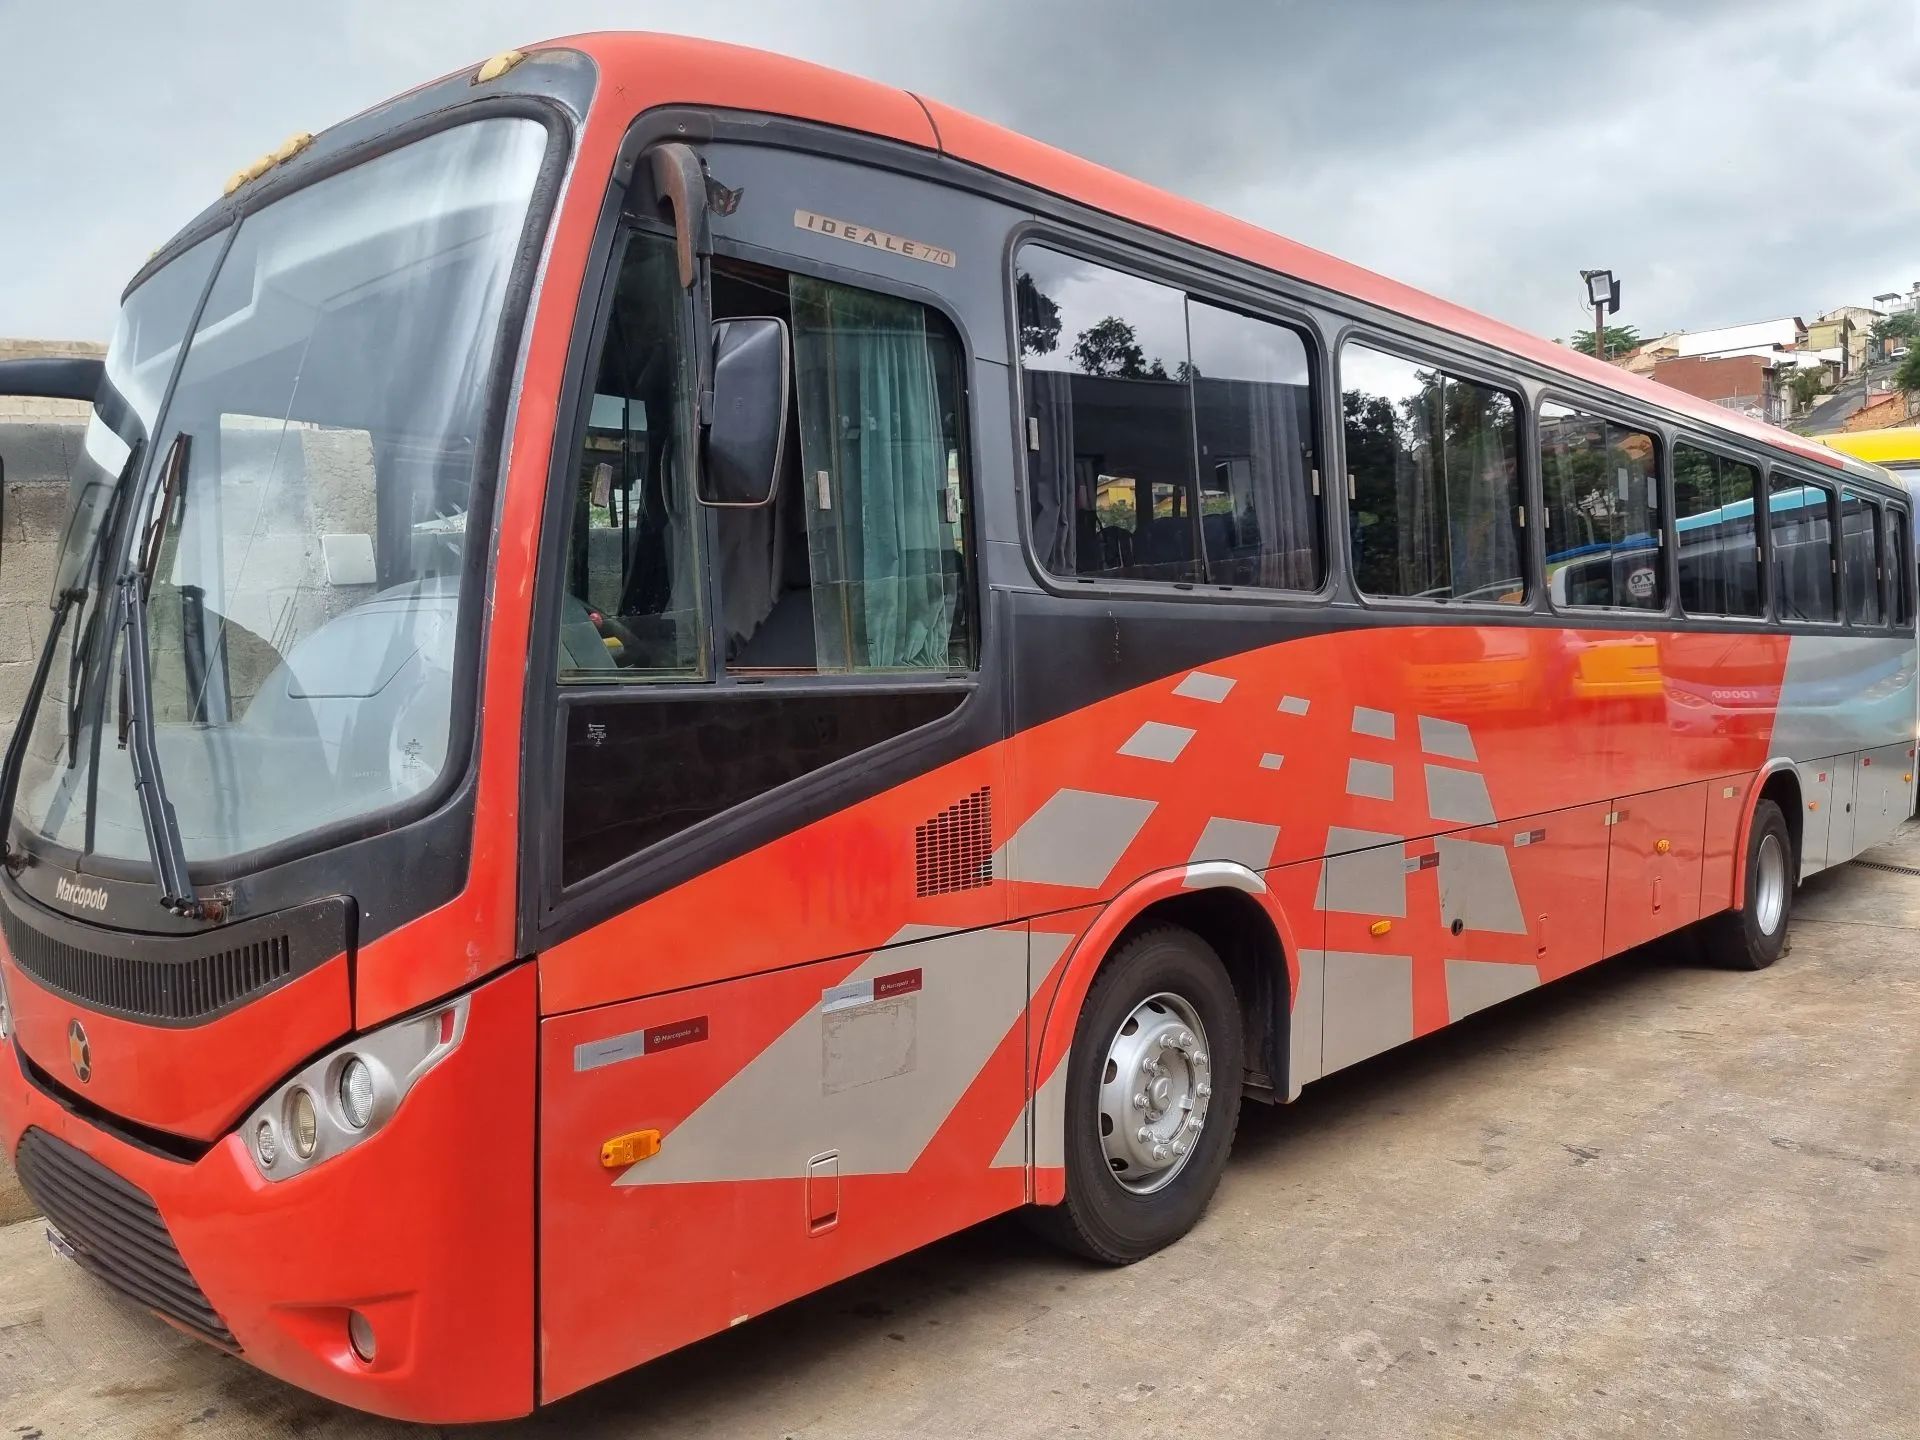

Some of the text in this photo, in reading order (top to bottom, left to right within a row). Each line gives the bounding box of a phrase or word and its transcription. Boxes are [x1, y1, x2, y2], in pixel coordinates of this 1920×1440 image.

[807, 215, 951, 265] IDEALE 770
[56, 877, 108, 910] Marcopolo
[661, 1029, 692, 1041] Marcopolo
